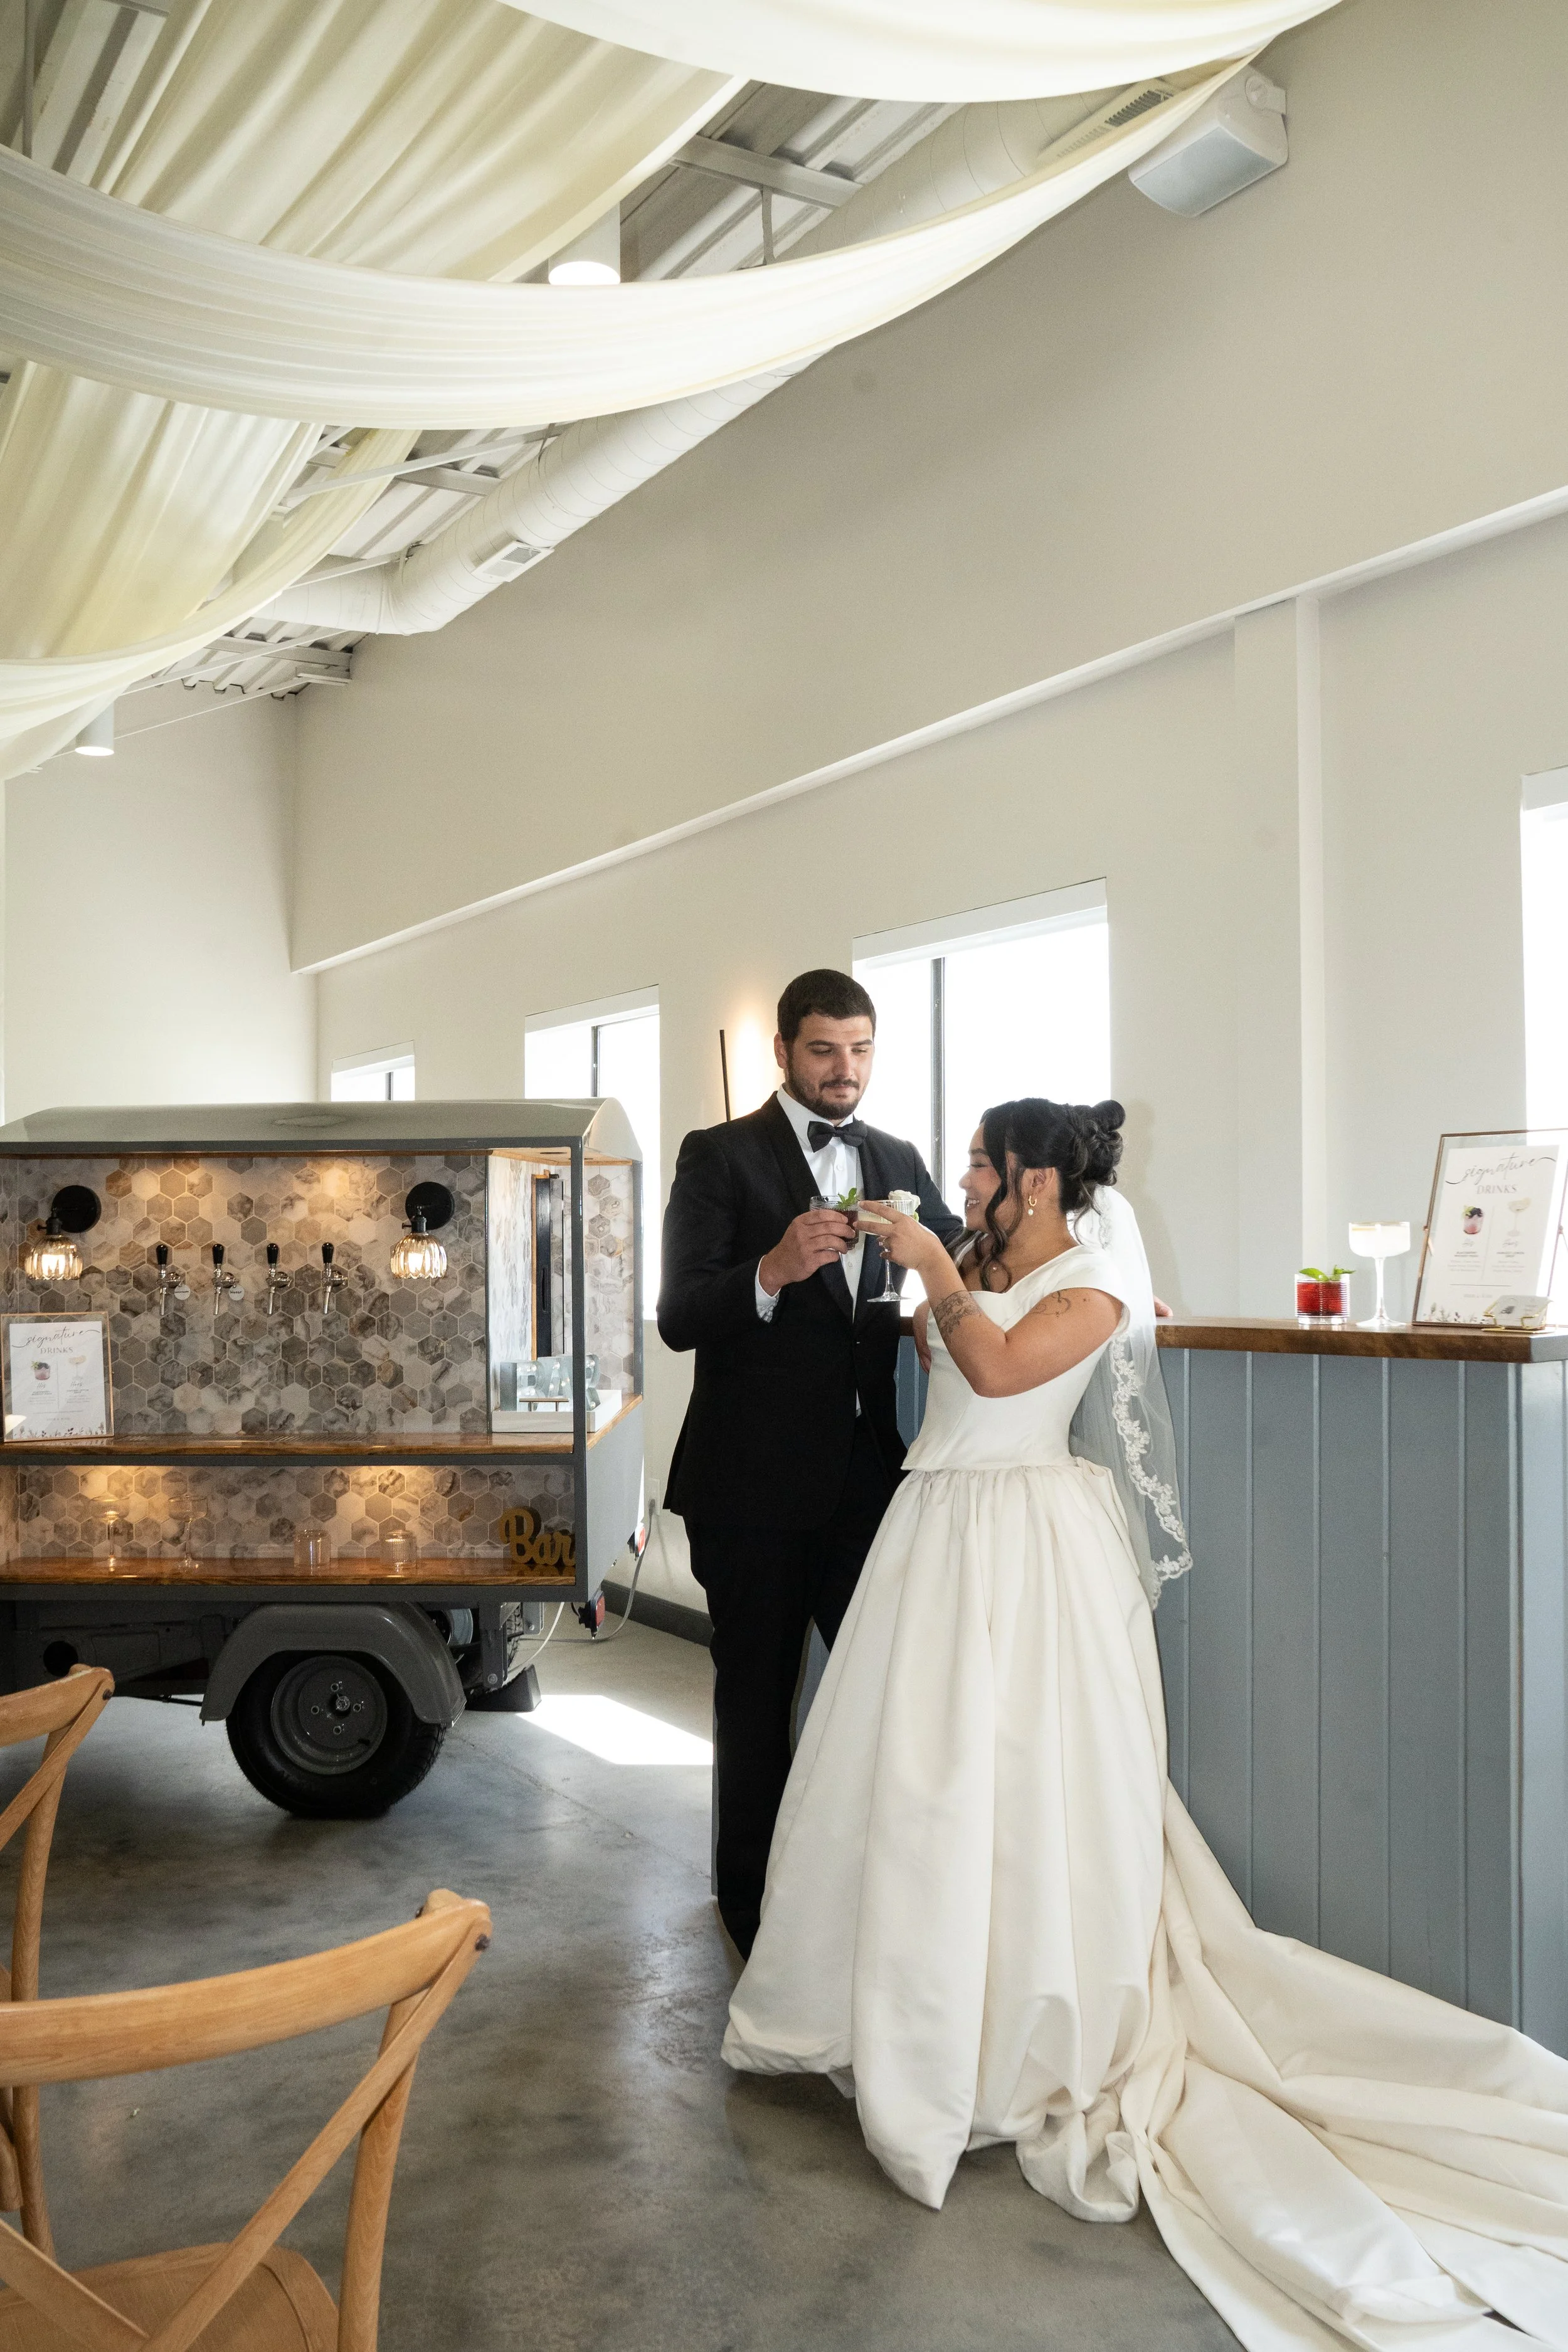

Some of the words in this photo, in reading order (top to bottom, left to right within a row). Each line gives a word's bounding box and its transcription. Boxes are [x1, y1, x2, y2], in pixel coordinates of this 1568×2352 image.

[1445, 1152, 1557, 1185] signature
[1476, 1184, 1518, 1195] DRINKS
[11, 1326, 100, 1348] signature
[40, 1347, 73, 1355] DRINKS
[499, 1507, 575, 1566] Bar
